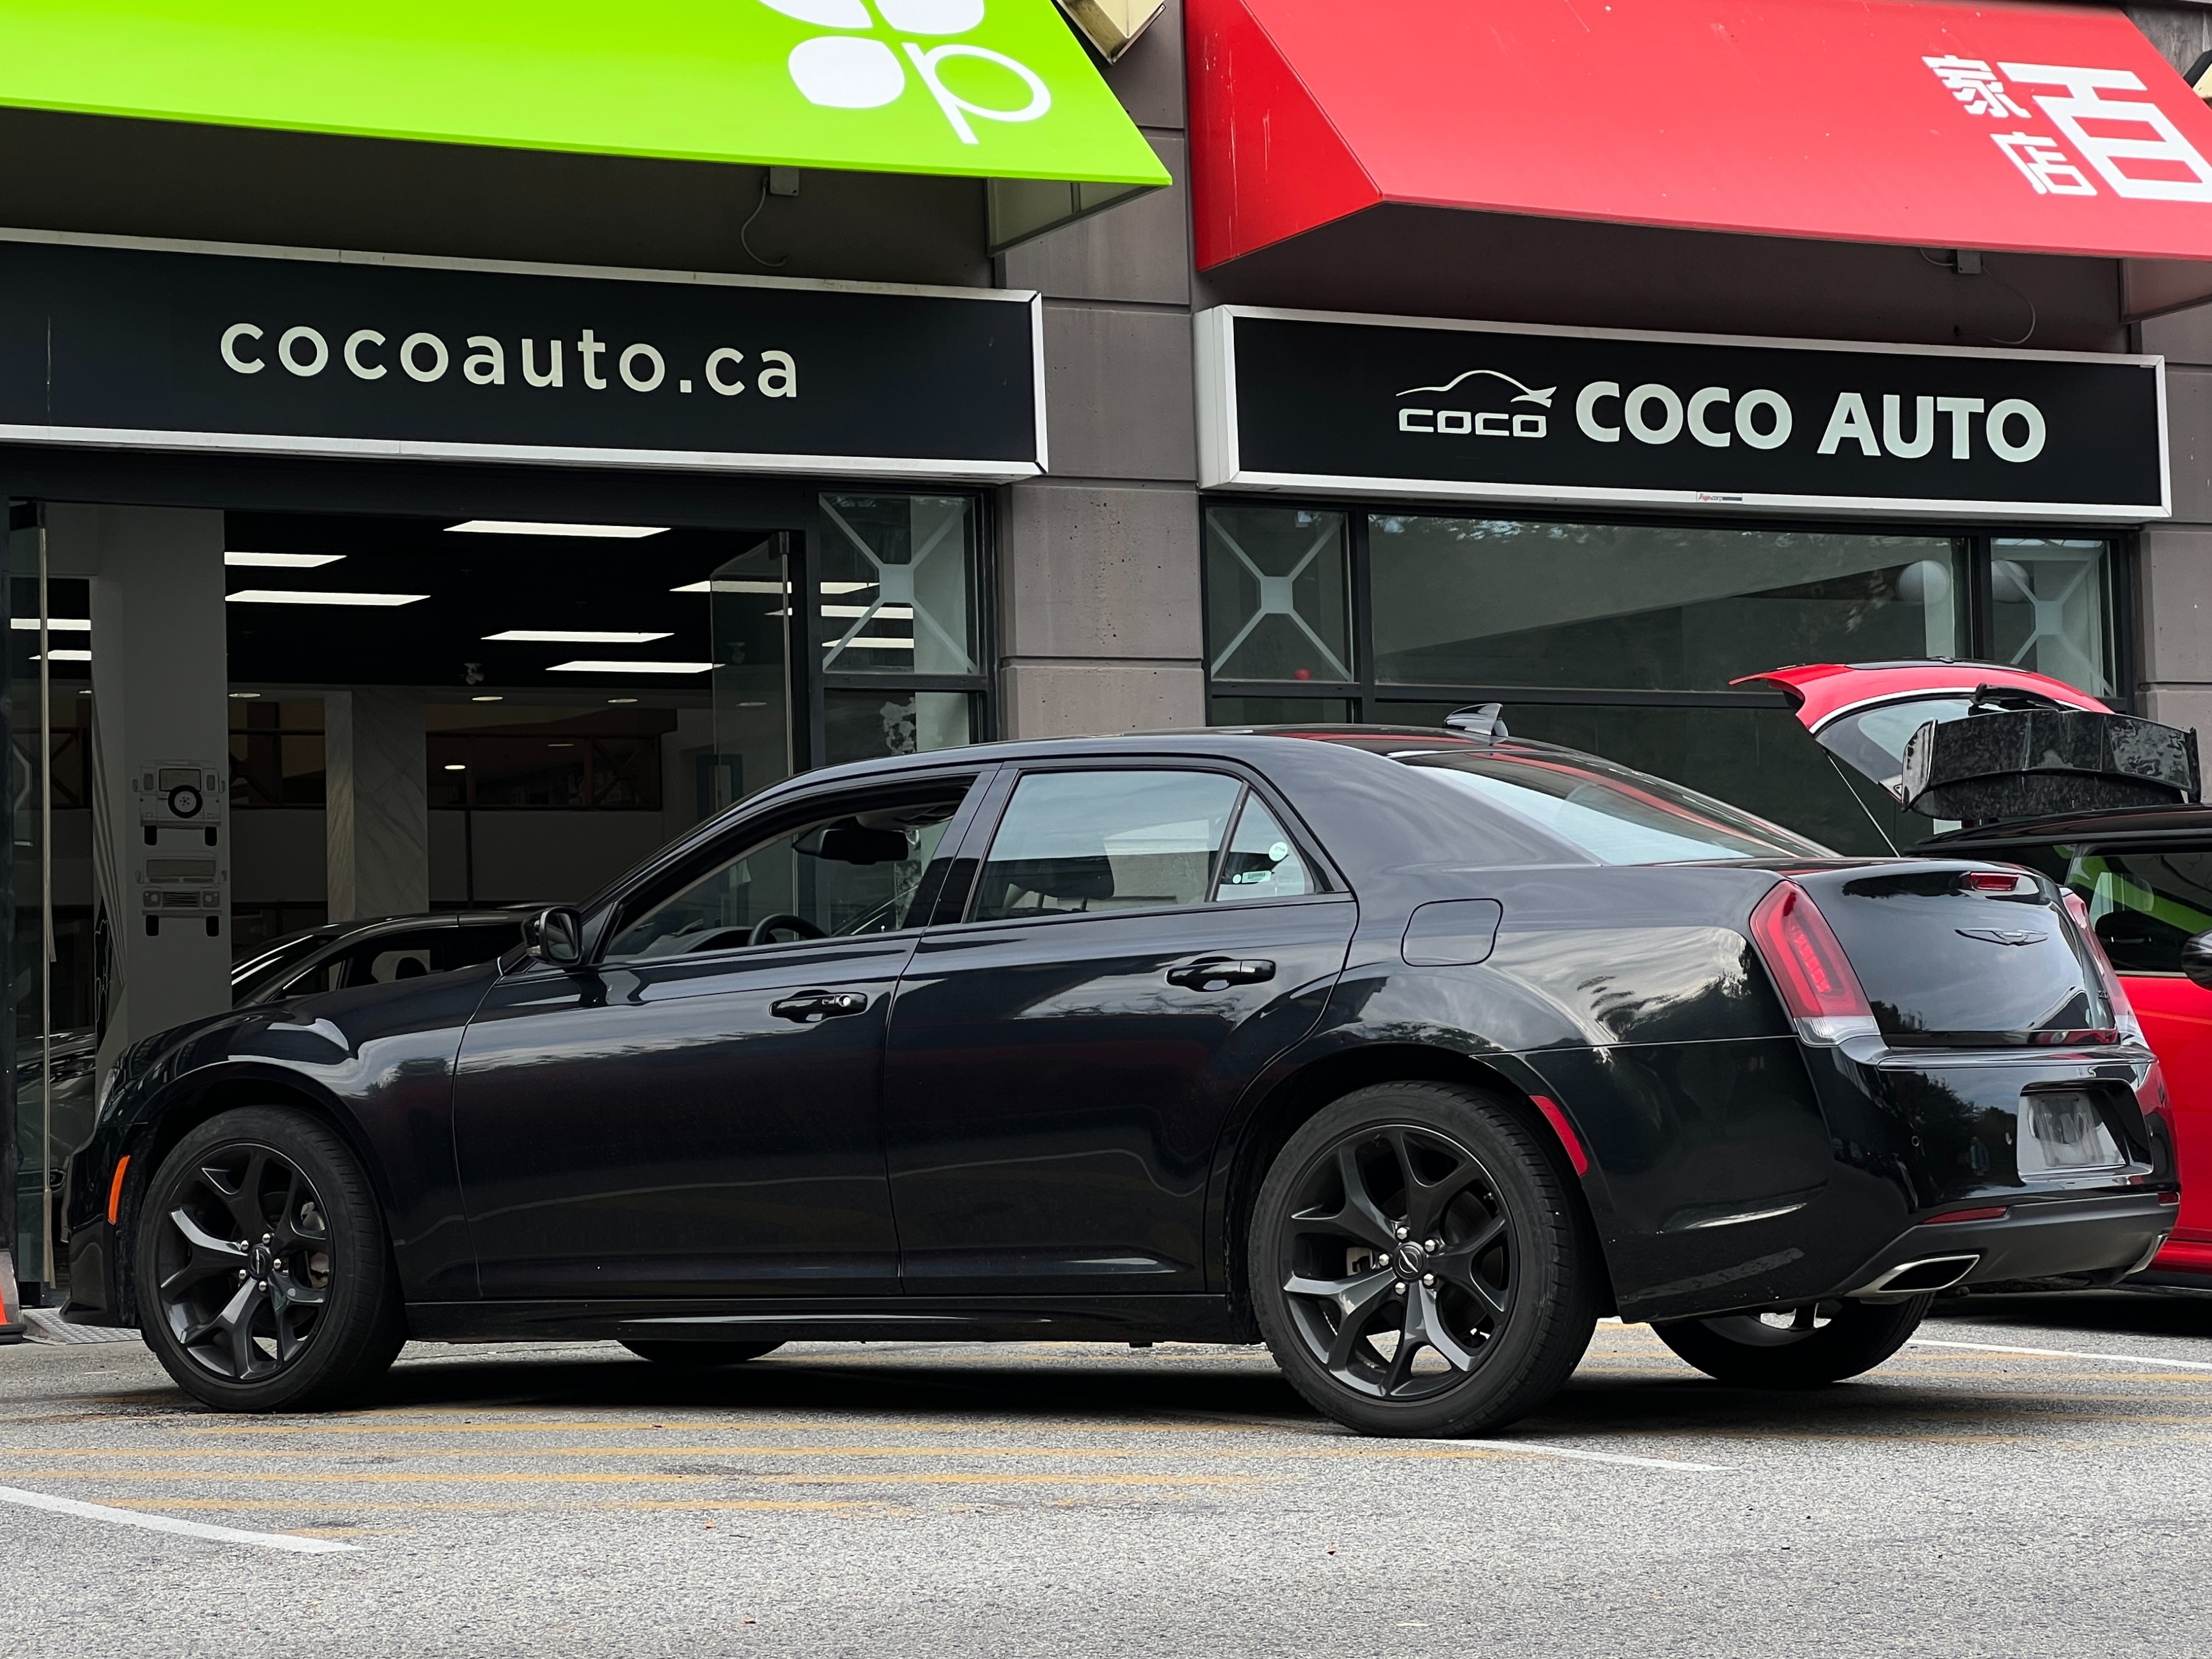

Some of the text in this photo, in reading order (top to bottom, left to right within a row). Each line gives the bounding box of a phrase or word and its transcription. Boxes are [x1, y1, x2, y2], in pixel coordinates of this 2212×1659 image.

[220, 323, 797, 398] cocoauto.ca
[1398, 408, 1547, 438] COCO
[1575, 380, 2047, 463] COCO AUTO
